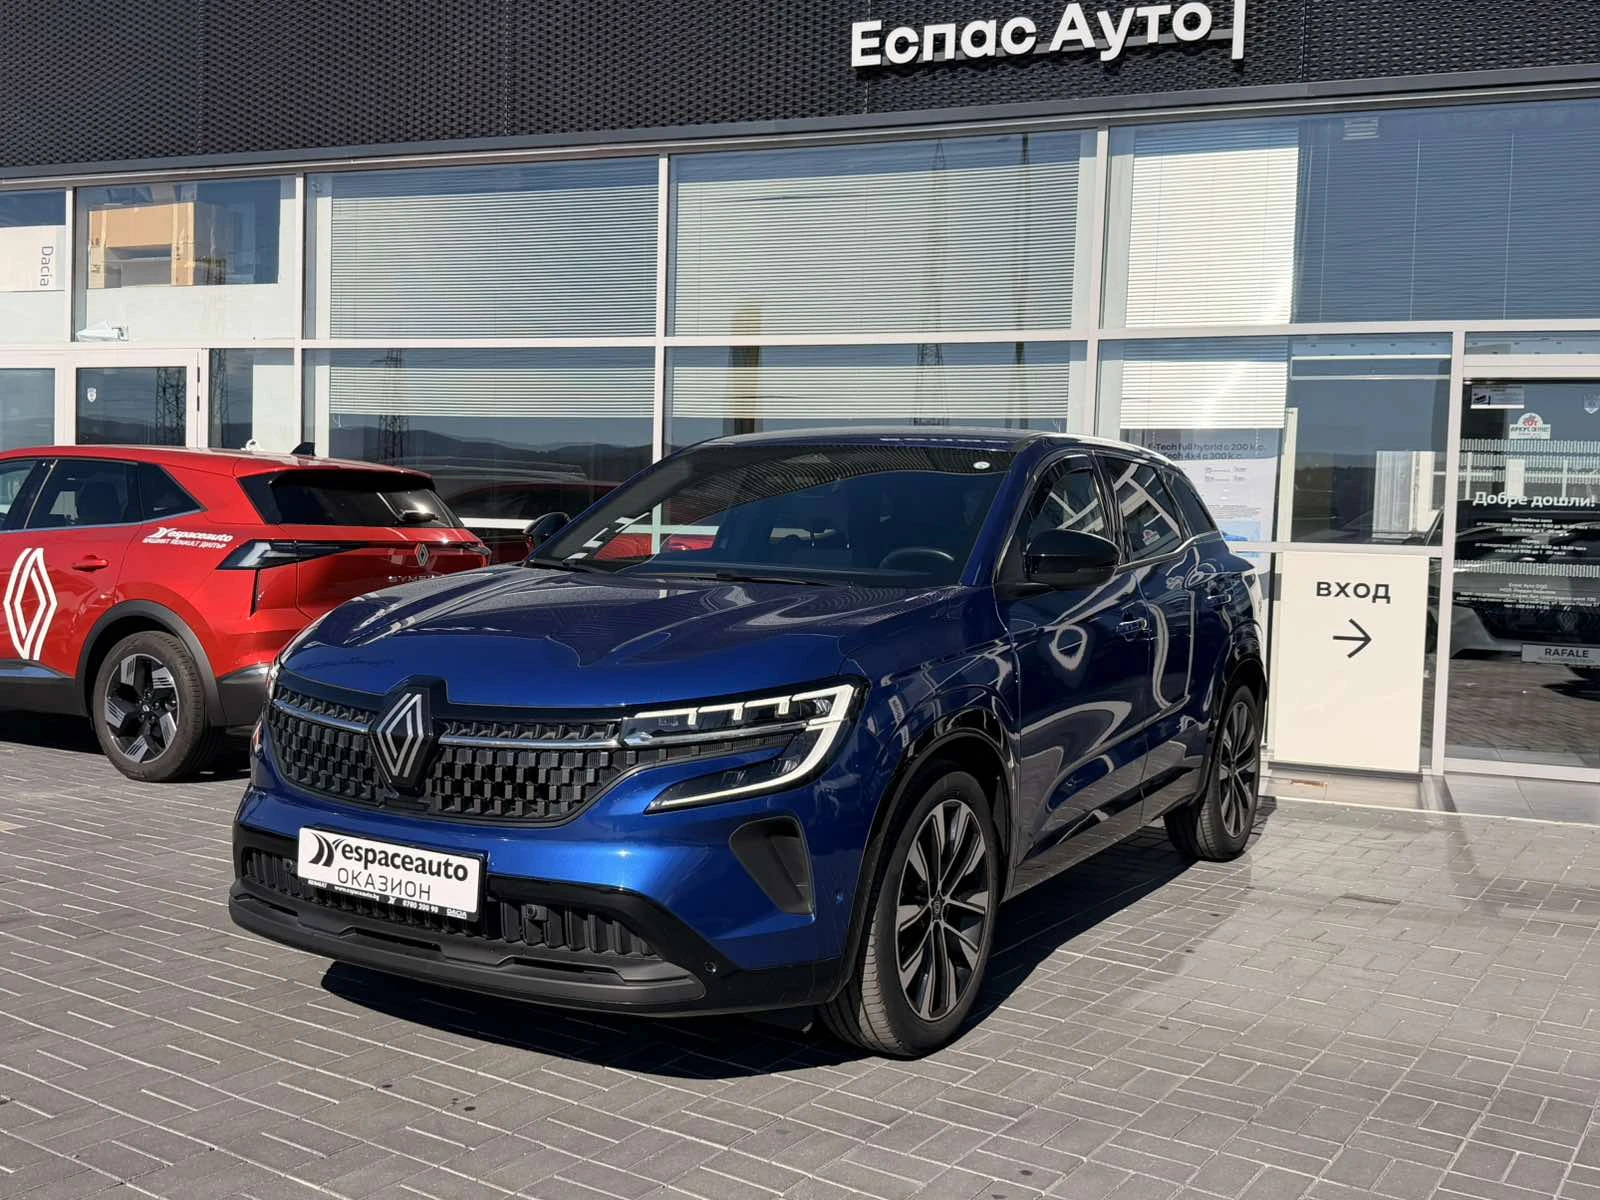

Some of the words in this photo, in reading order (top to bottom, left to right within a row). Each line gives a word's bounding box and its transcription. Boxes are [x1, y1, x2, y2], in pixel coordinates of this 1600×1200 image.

[851, 19, 1037, 68] Еспас
[1048, 2, 1213, 62] Ауто
[40, 246, 54, 287] Dacia
[1472, 491, 1528, 508] Добре
[1530, 495, 1596, 508] дошли!
[167, 530, 233, 542] espaceauto
[1545, 648, 1589, 658] RAFALE
[341, 842, 468, 881] espaceauto
[337, 867, 432, 901] ОКАЗИОН
